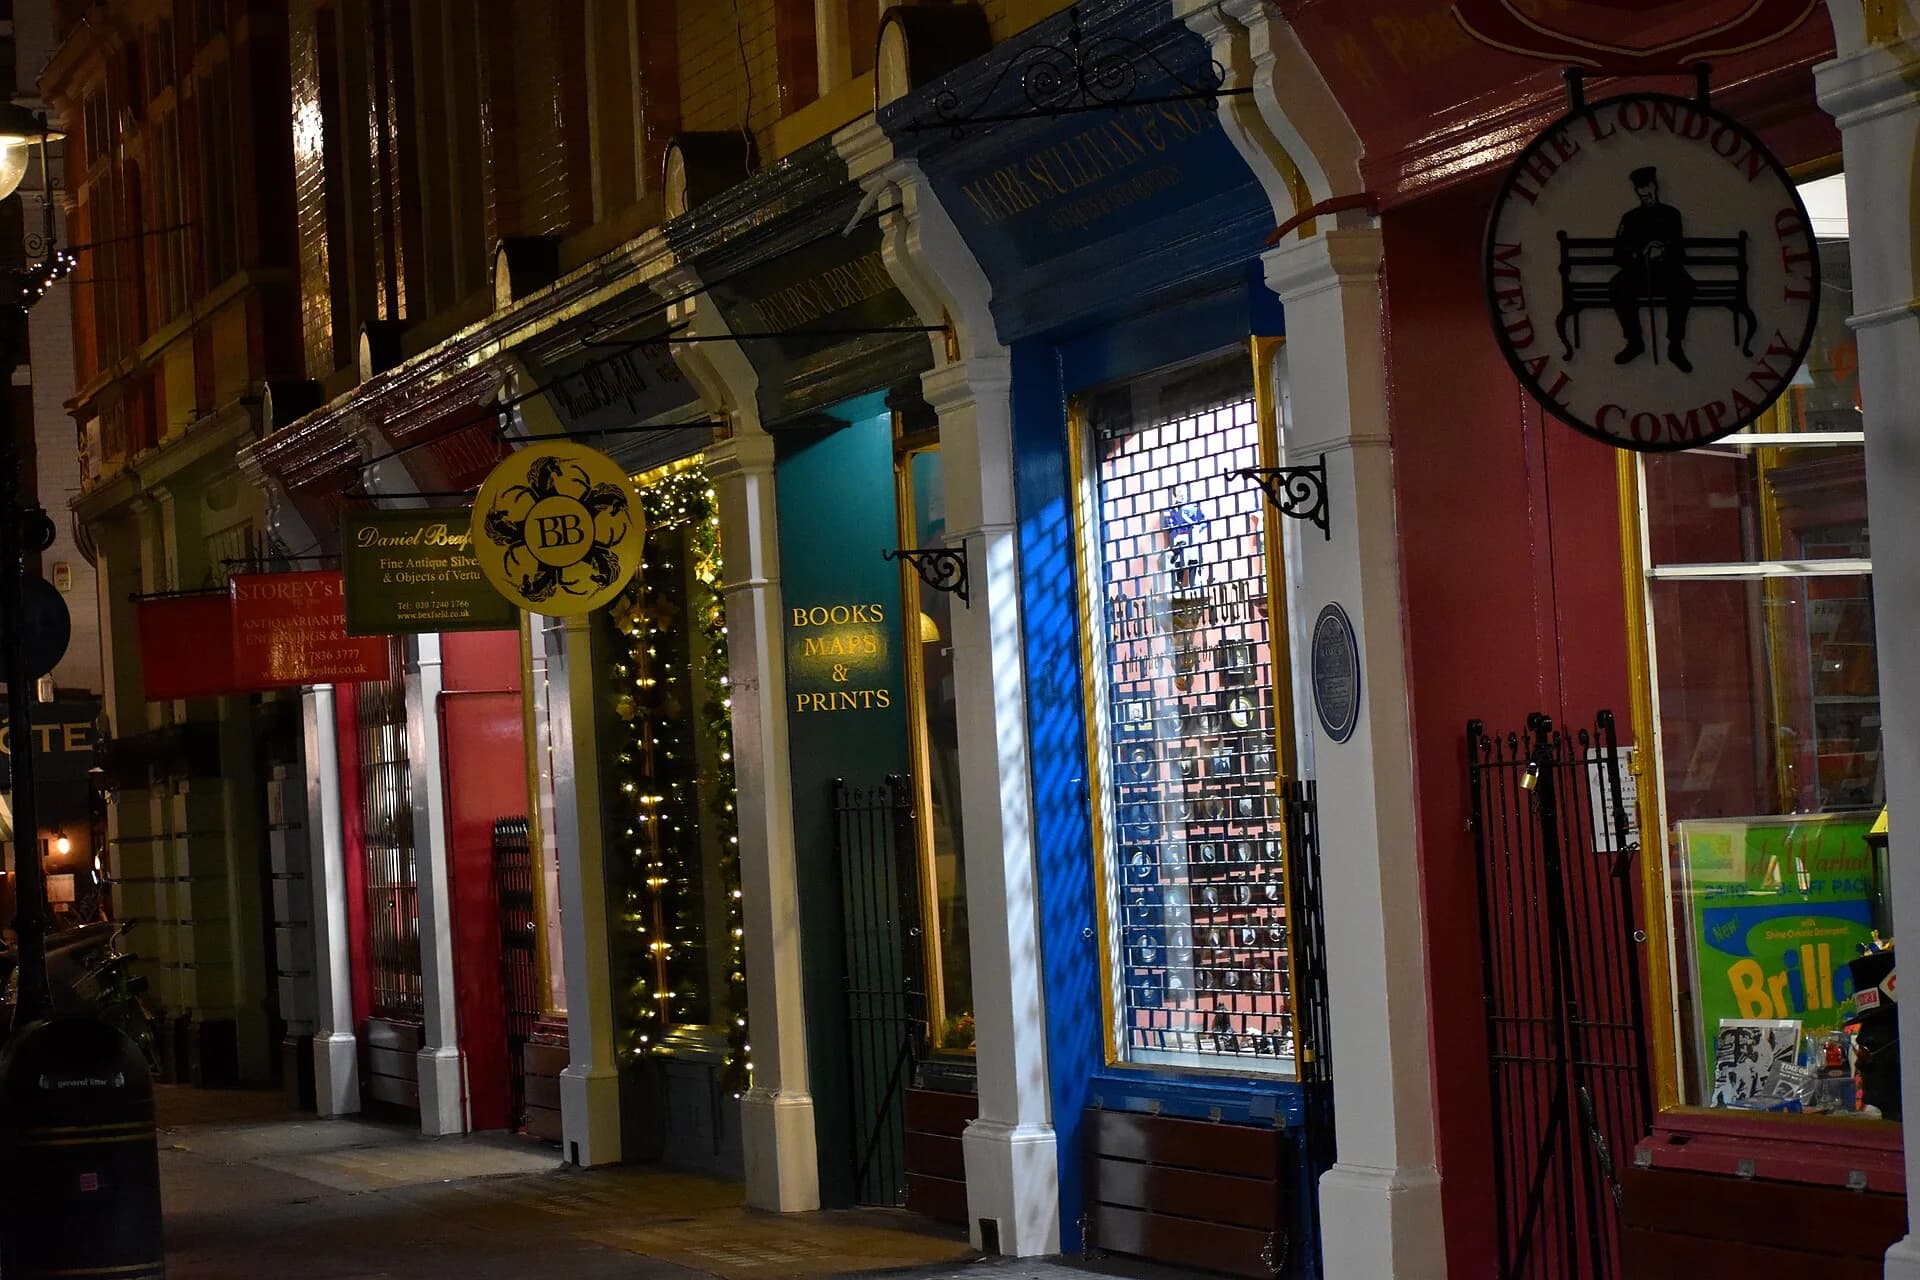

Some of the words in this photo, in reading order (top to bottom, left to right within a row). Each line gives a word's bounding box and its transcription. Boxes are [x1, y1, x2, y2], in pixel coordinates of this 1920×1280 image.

[1511, 128, 1580, 206] THE
[1588, 99, 1769, 182] LONDON
[961, 163, 1041, 224] MARK
[1493, 242, 1574, 409] MEDAL
[1595, 331, 1799, 445] COMPANY
[1775, 208, 1814, 302] LTD
[358, 526, 423, 548] Daniel
[535, 514, 585, 549] BB
[380, 558, 403, 569] Fine
[406, 557, 448, 570] Antique
[451, 555, 480, 567] Silve
[383, 573, 392, 583] &
[395, 571, 436, 584] Objects
[438, 569, 451, 581] of
[451, 569, 480, 580] Vertu
[792, 604, 884, 627] BOOKS
[804, 635, 877, 657] MAPS
[832, 663, 848, 682] &
[796, 690, 891, 712] PRINTS
[1728, 943, 1855, 1019] Brillo
